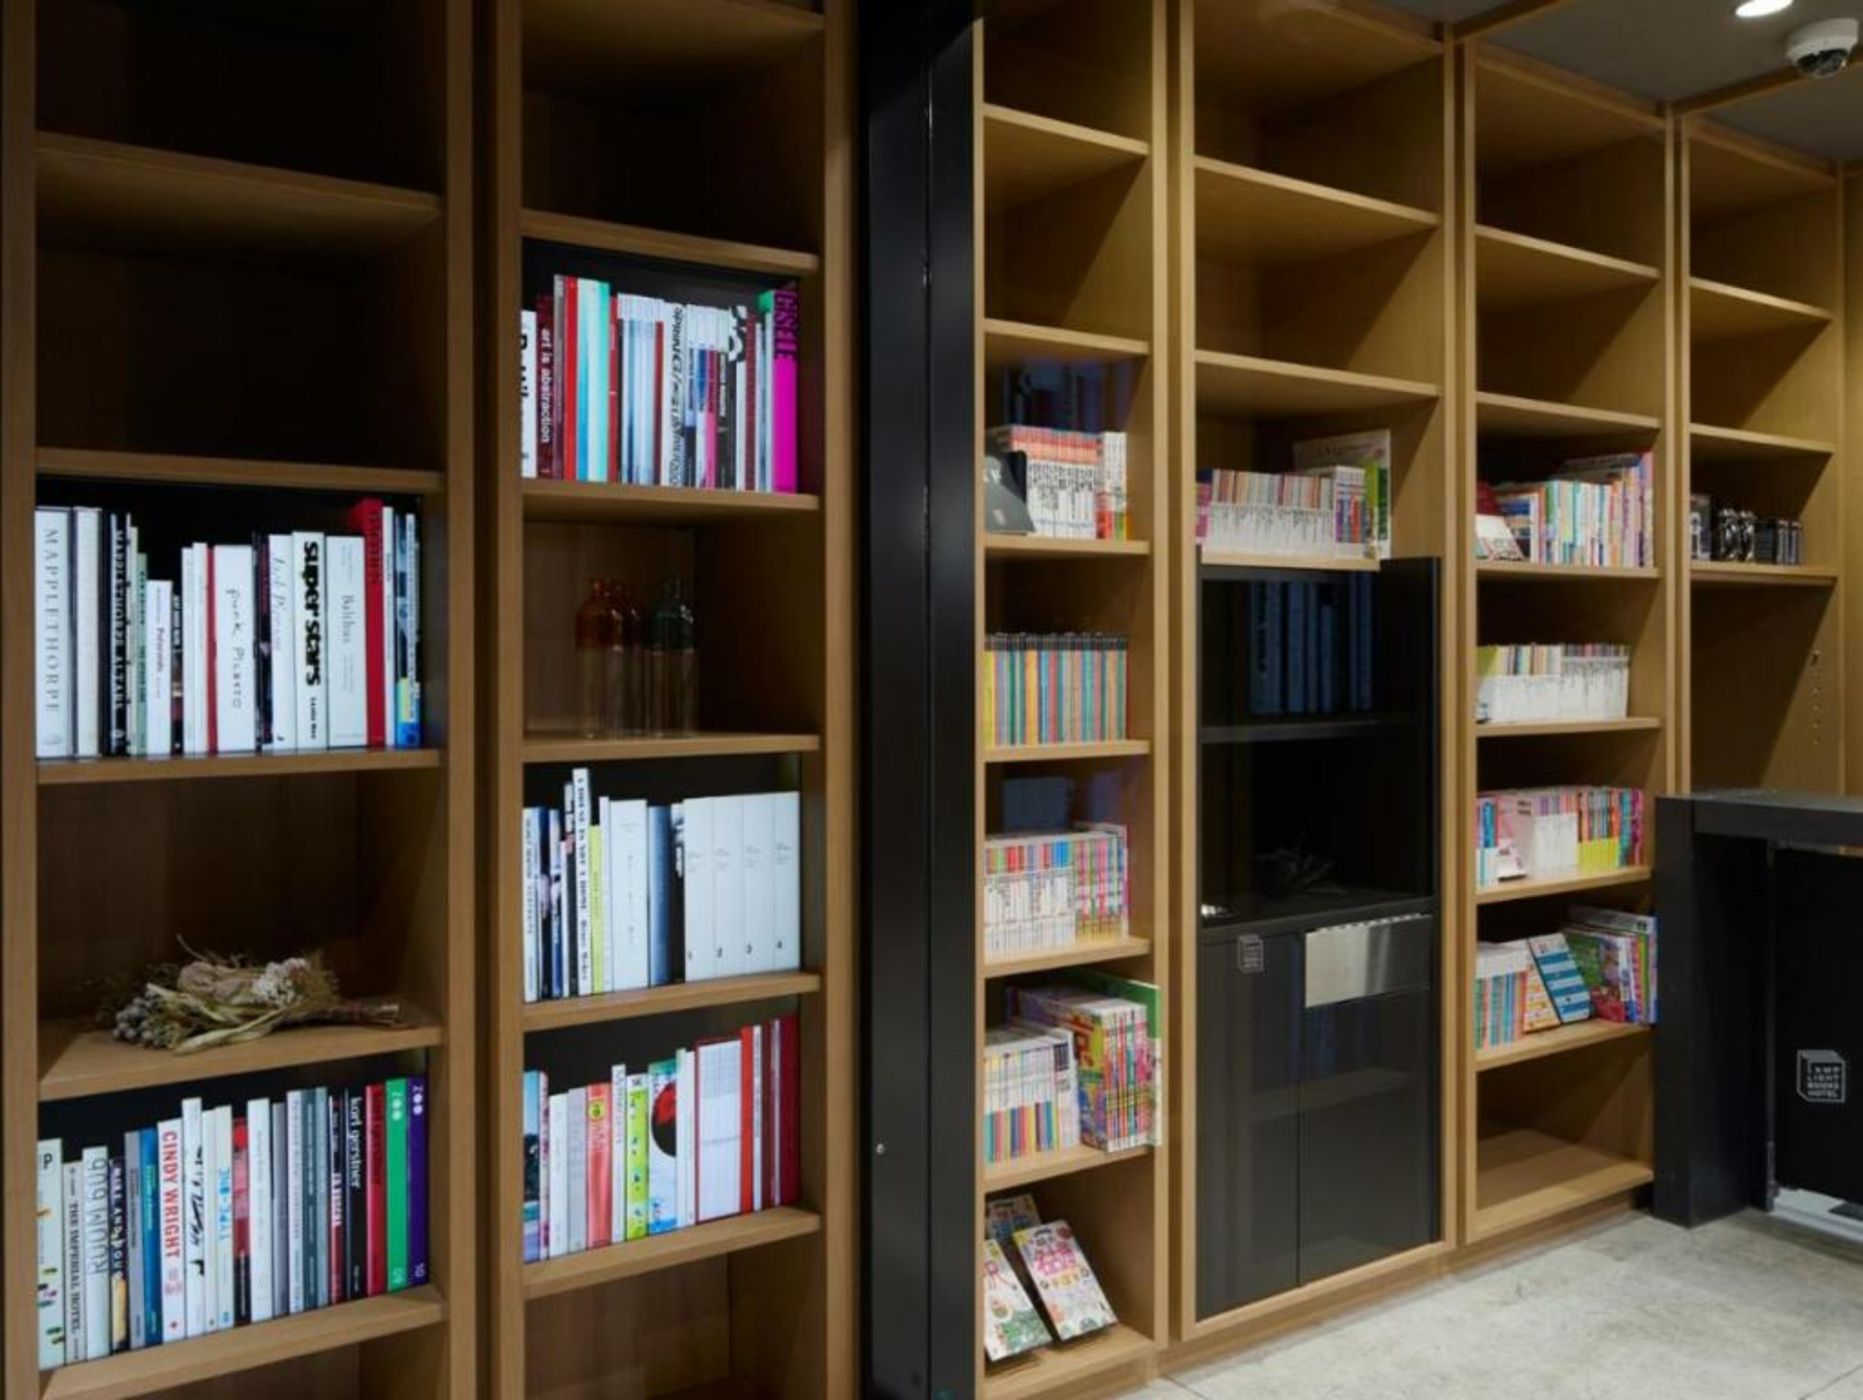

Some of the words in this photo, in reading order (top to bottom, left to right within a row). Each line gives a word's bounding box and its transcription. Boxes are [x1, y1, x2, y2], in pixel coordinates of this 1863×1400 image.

[541, 328, 550, 348] art
[541, 352, 551, 363] is
[540, 368, 551, 443] abstraction
[115, 529, 126, 646] MAPPLETHORPE
[43, 529, 59, 712] MAPPLETHORPE
[341, 595, 355, 644] Balthus
[162, 1131, 178, 1184] CINDY
[347, 1129, 362, 1189] gerstner
[70, 1202, 78, 1228] THE
[164, 1188, 180, 1258] WRIGHT
[70, 1229, 79, 1291] IMPERIAL
[71, 1292, 80, 1333] HOTEL
